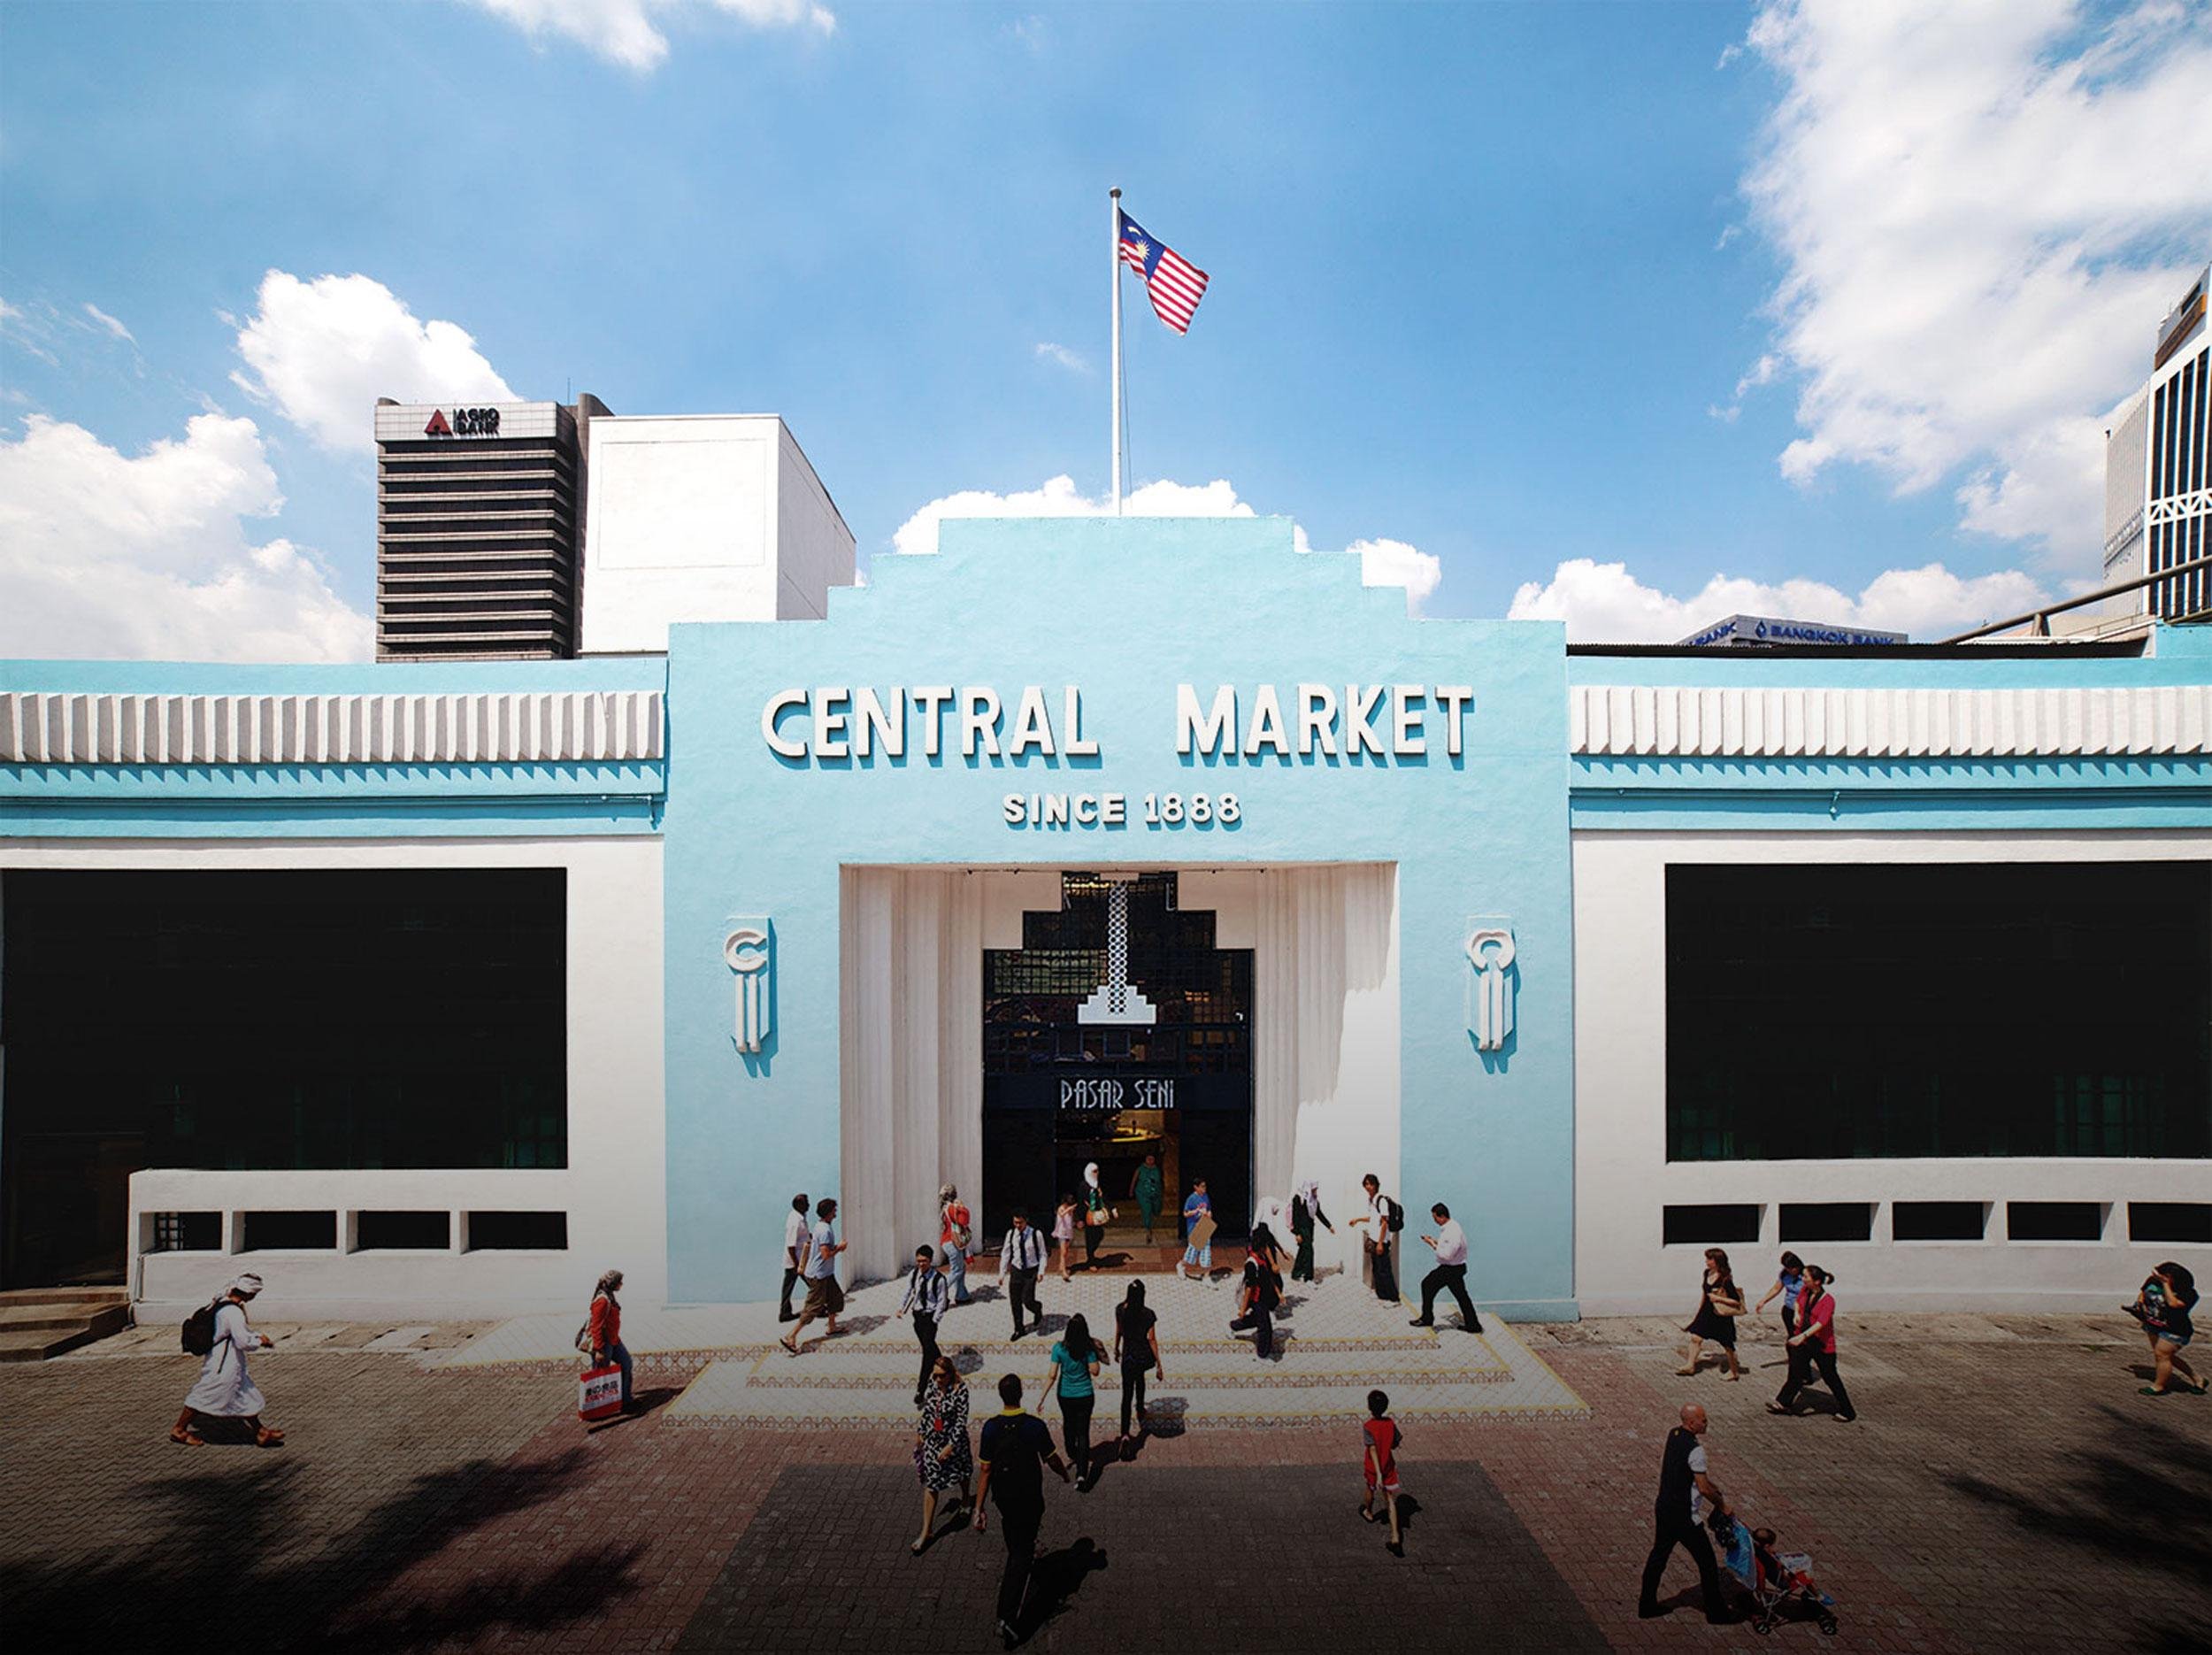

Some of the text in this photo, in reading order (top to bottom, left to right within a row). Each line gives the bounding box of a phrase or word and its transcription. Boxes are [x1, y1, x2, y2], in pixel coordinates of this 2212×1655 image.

[1770, 625, 1894, 645] BANGKOK BANK
[761, 684, 1474, 758] CENTRAL MARKET
[1003, 793, 1242, 826] SINCE 1888
[1061, 1079, 1174, 1109] PASAR SENI
